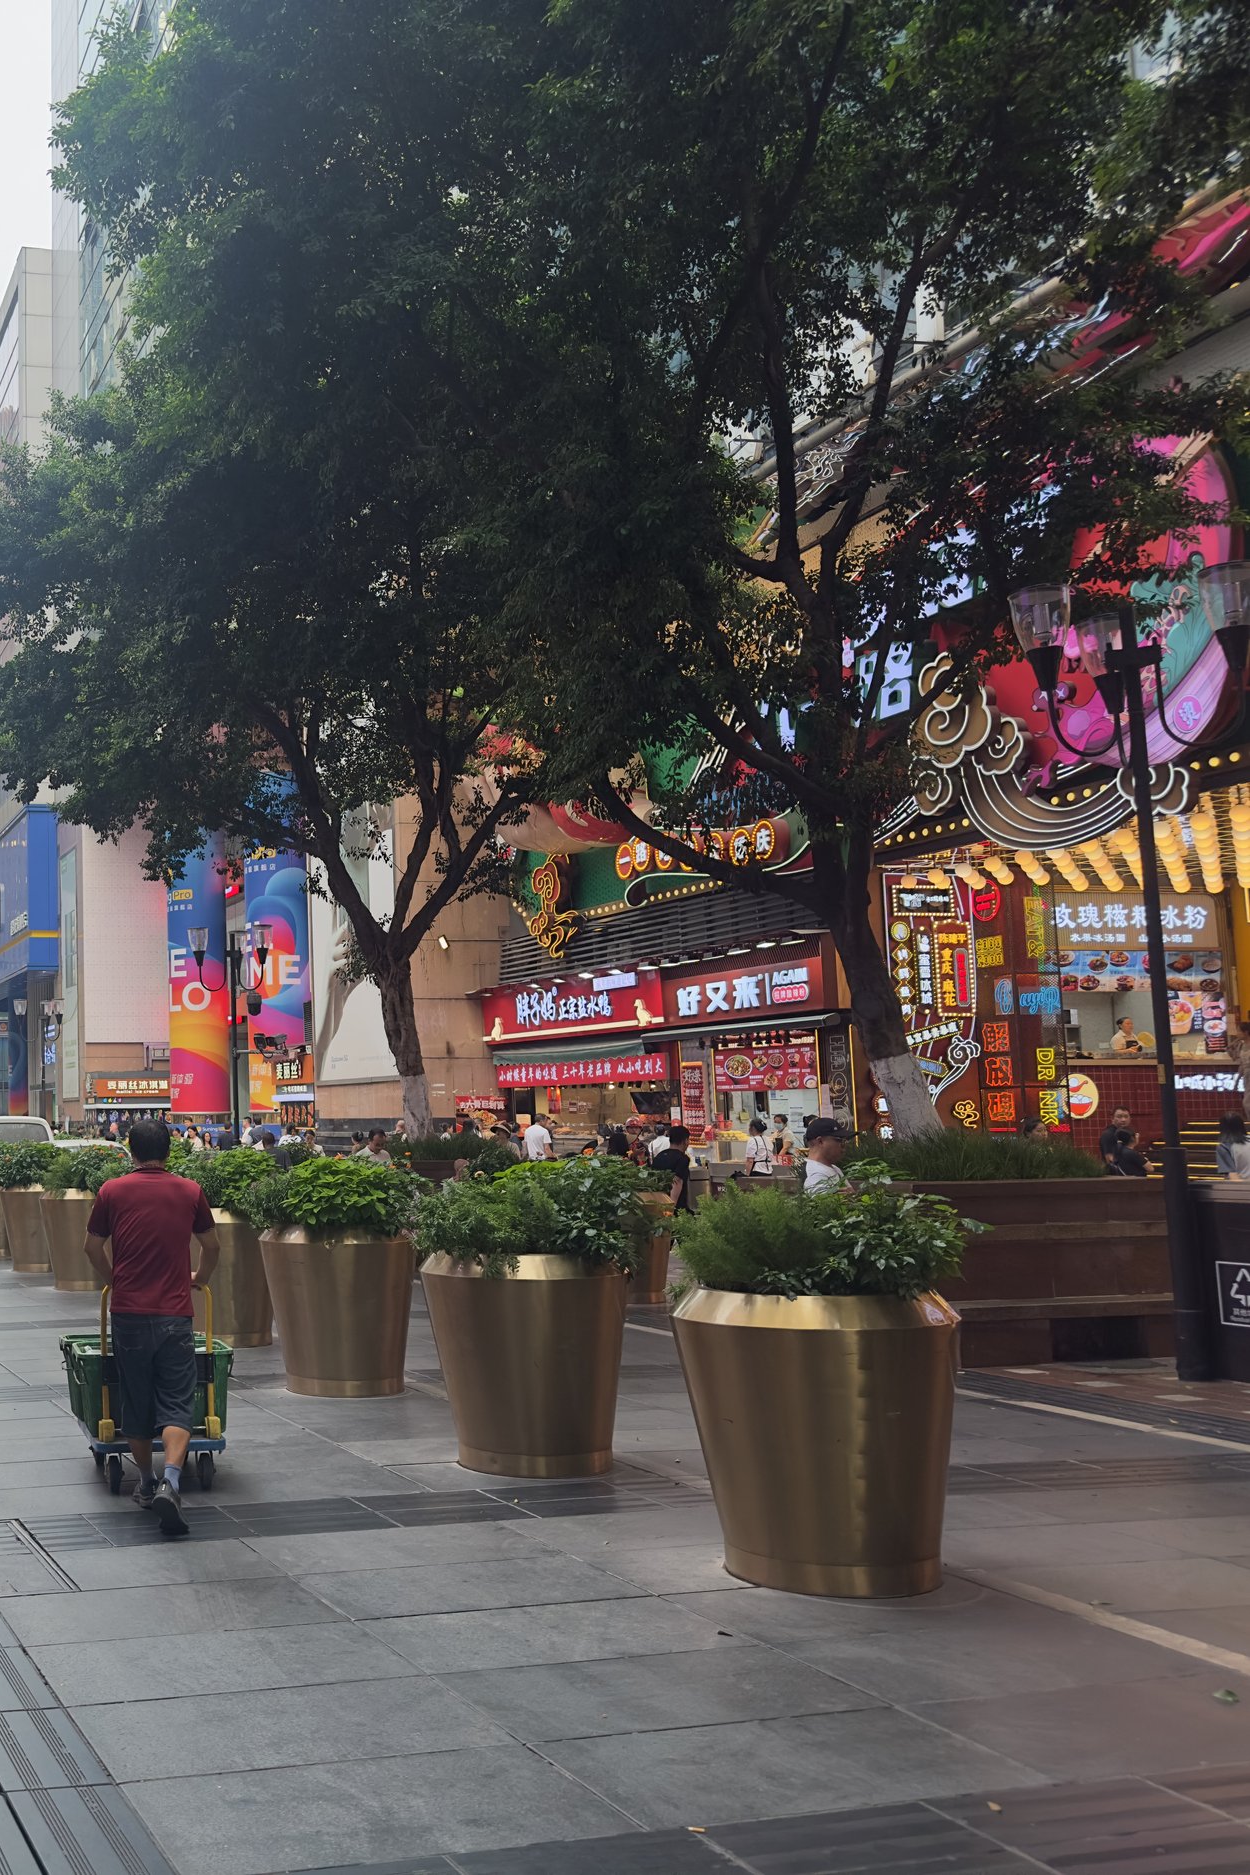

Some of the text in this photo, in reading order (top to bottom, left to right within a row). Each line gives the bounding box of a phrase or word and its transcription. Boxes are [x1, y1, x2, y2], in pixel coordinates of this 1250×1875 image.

[772, 967, 808, 985] AGAIN
[515, 988, 612, 1028] 胖子妈 正宗盐水鸭
[677, 975, 760, 1017] 好又来
[562, 1061, 612, 1079] 三十年老品牌
[617, 1058, 663, 1075] 从小吃到大
